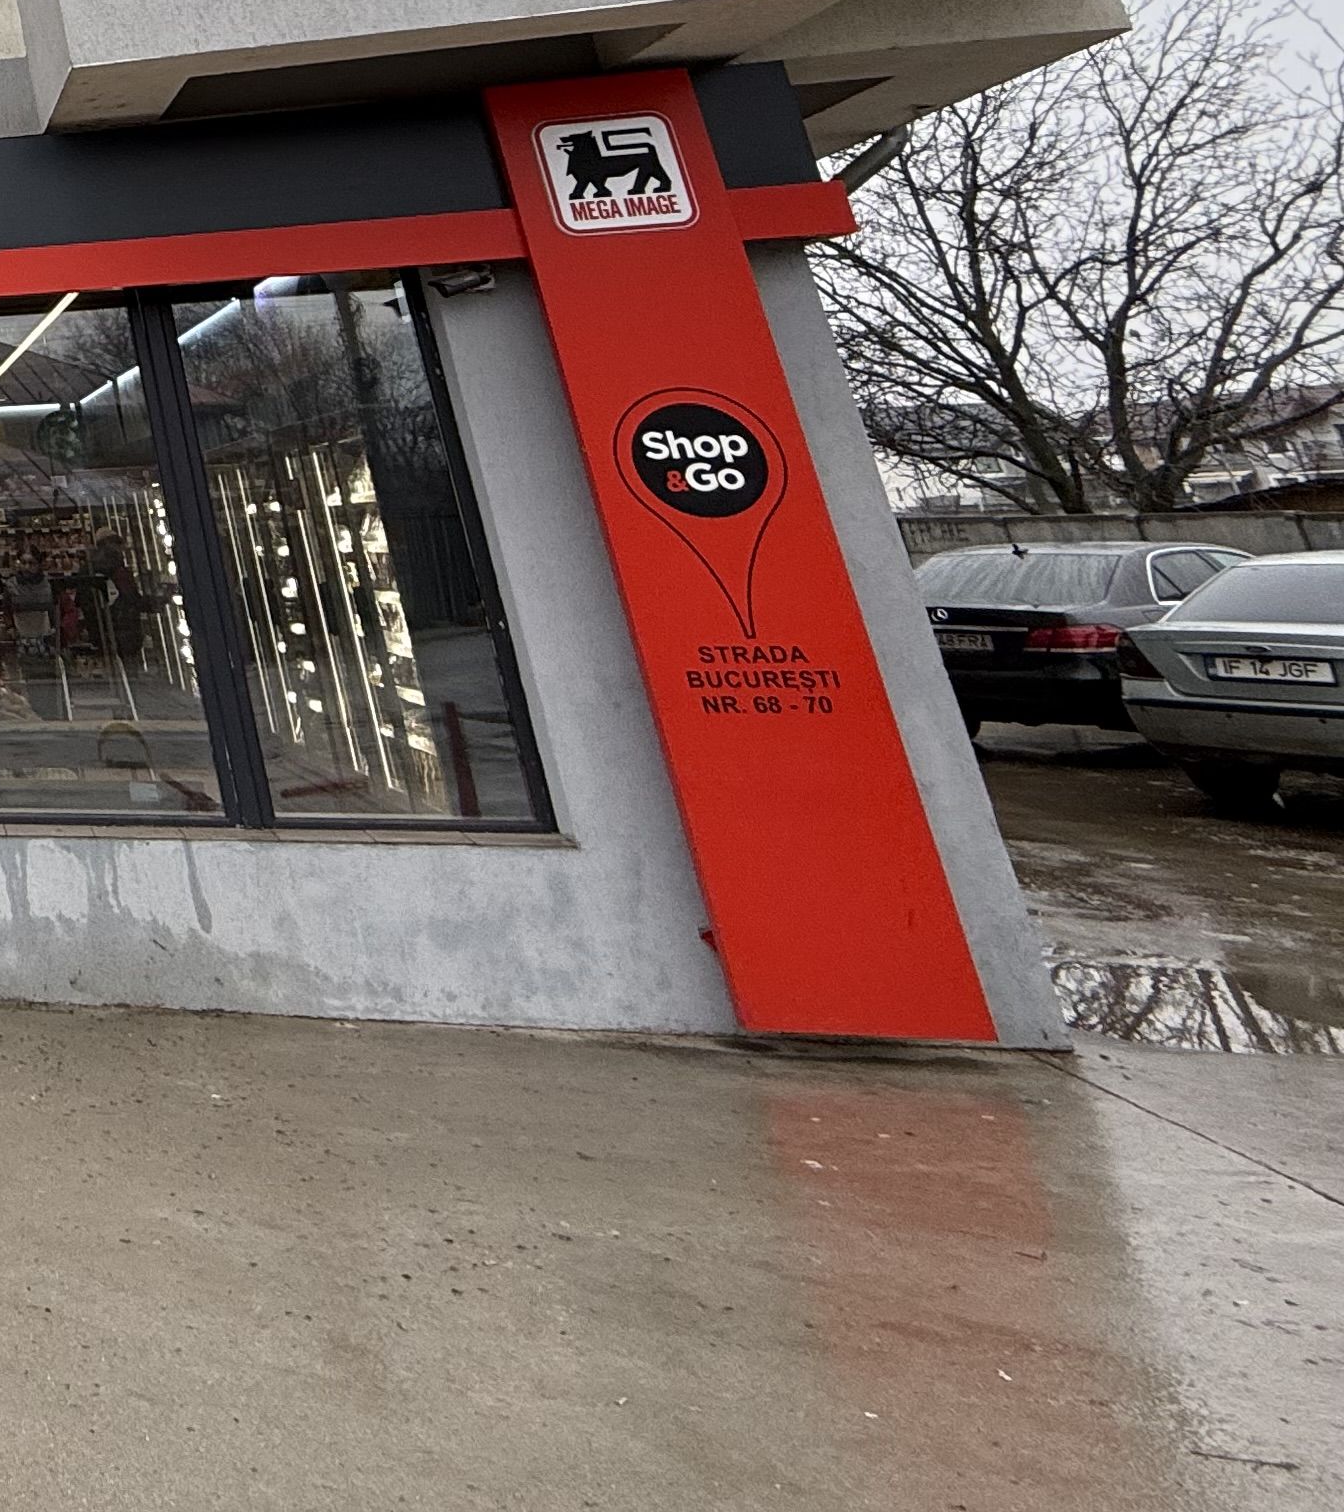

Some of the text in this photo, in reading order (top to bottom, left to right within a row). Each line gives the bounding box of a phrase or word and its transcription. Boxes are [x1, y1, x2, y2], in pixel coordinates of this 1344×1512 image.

[570, 194, 682, 221] MEGA IMAGE
[642, 430, 749, 462] Shop
[666, 462, 746, 492] &Go
[698, 645, 810, 664] STRADA
[1222, 659, 1319, 678] IF 14 JGF
[701, 695, 747, 714] NR.
[753, 695, 783, 714] 68
[802, 695, 834, 714] 70
